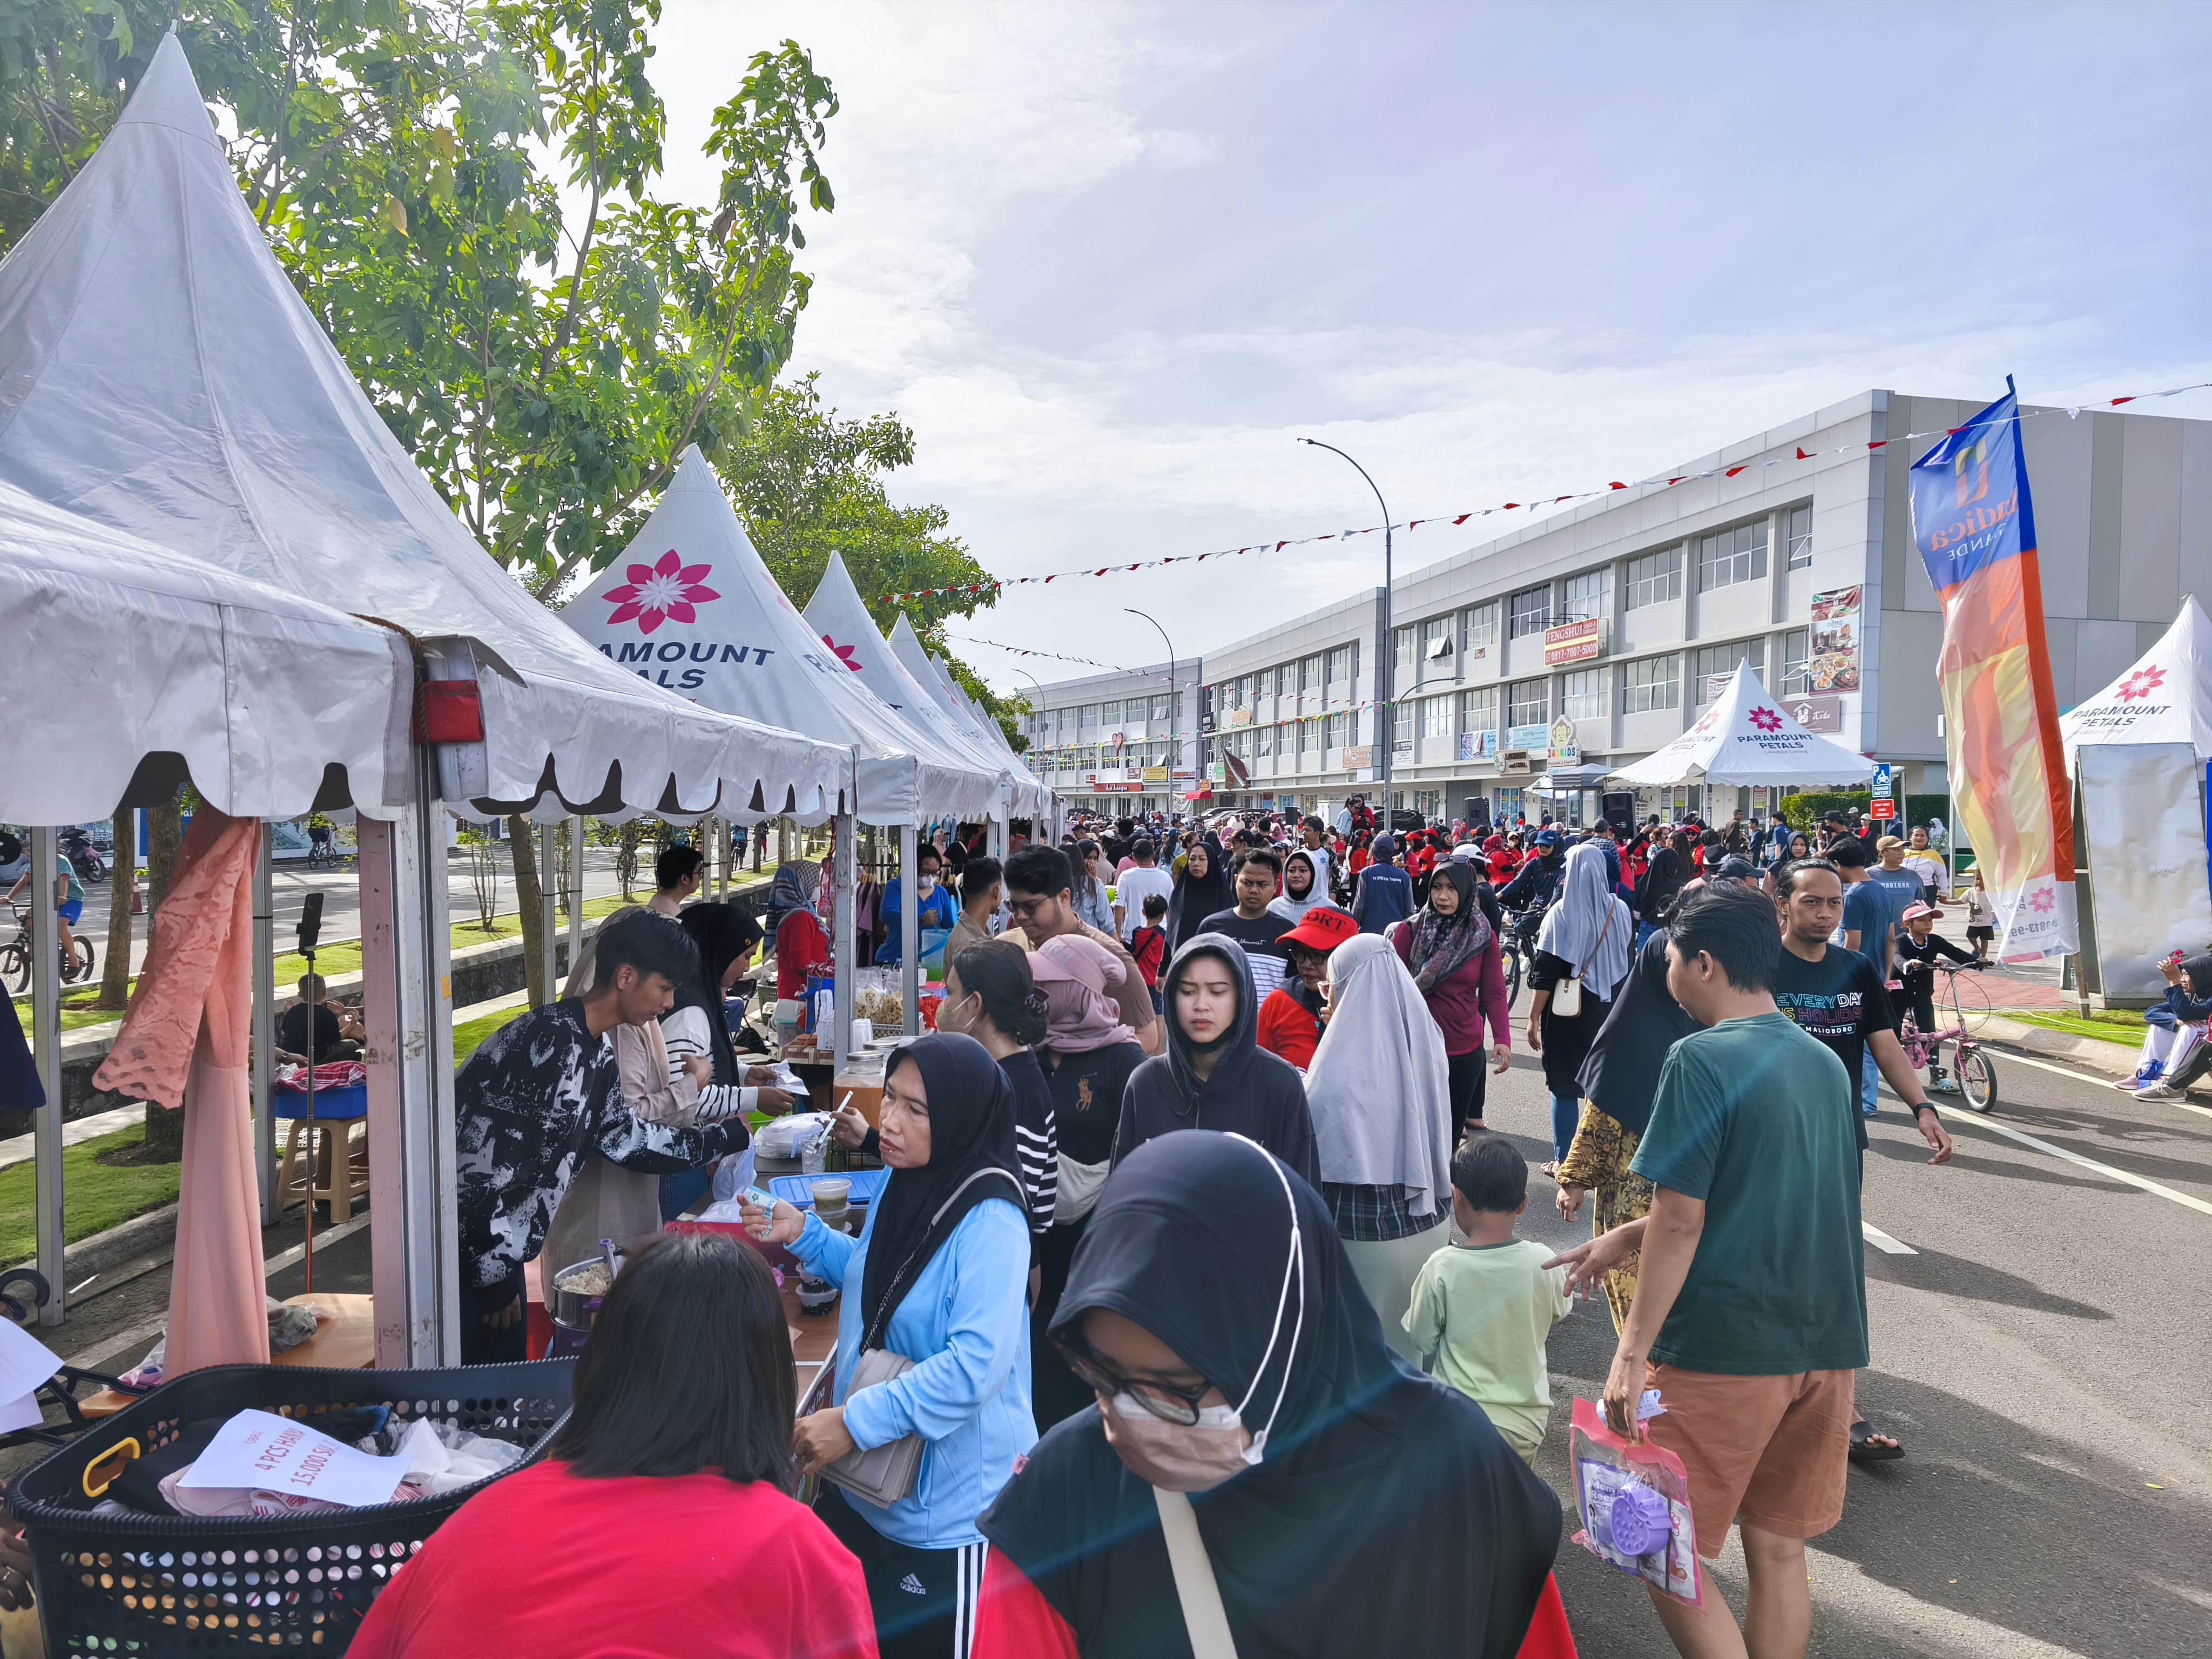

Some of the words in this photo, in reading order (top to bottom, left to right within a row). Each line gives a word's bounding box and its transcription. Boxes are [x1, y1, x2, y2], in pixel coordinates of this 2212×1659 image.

[1547, 625, 1583, 643] FENGSHUI
[2071, 706, 2171, 719] PARAMOUNT
[2082, 717, 2136, 727] PETALS
[1737, 734, 1813, 743] PARAMOUNT
[1873, 765, 1879, 776] P
[1798, 1007, 1864, 1023] HOLIDAY
[1805, 1026, 1852, 1034] MALIOBORO
[259, 1445, 290, 1464] PCS
[291, 1454, 328, 1486] 15.000
[900, 1582, 926, 1595] adidas
